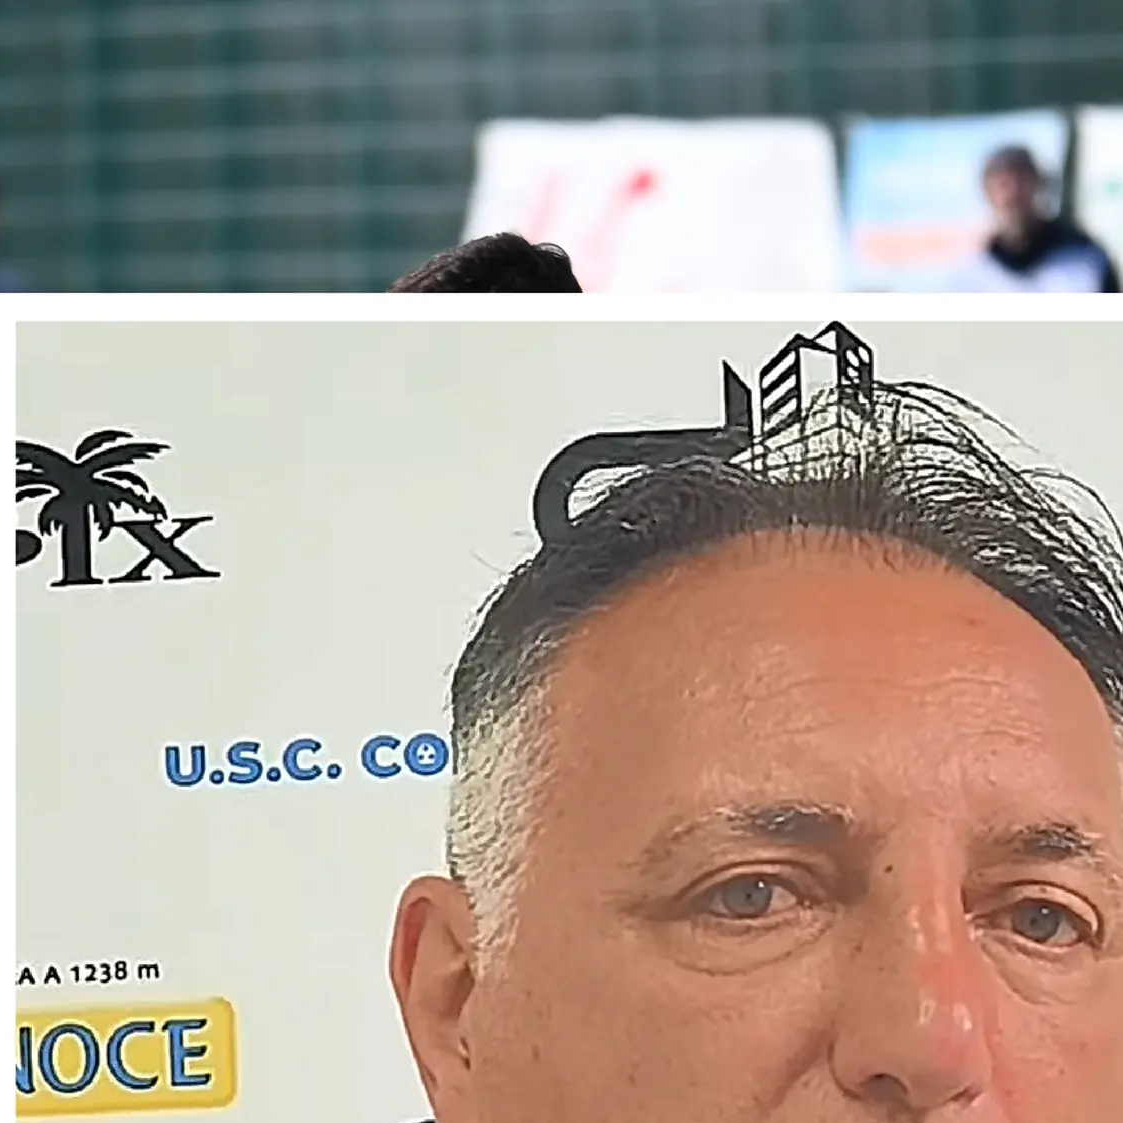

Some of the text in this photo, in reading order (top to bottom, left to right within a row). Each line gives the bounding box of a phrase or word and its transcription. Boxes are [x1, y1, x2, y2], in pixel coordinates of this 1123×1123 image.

[165, 738, 342, 787] U.S.C.
[16, 961, 160, 985] A A 1238 m
